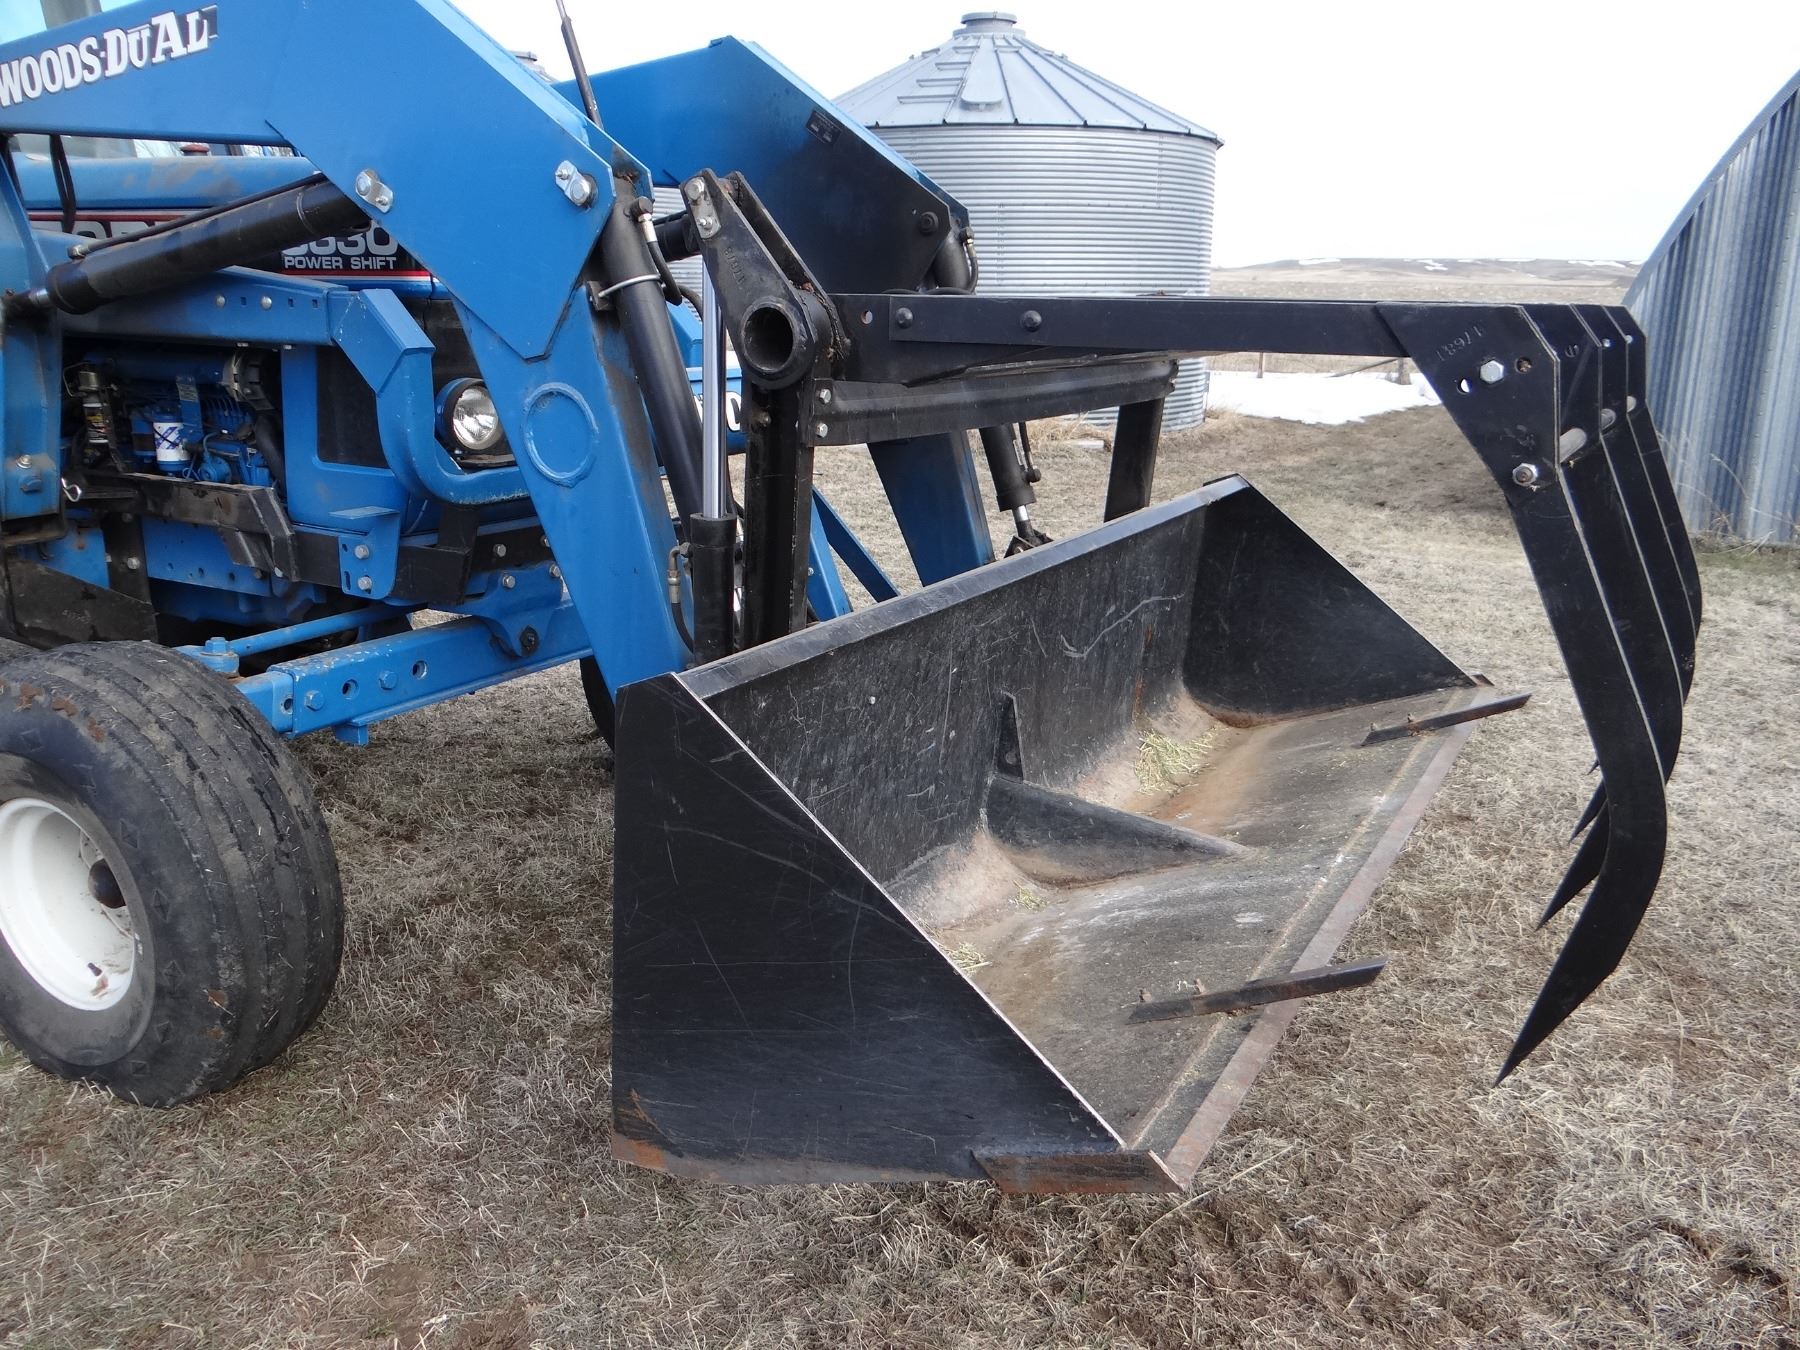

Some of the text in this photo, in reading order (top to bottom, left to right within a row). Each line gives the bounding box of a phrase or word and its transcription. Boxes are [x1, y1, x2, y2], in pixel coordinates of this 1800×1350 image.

[281, 219, 398, 256] 30
[284, 256, 397, 270] POWER SHIFT
